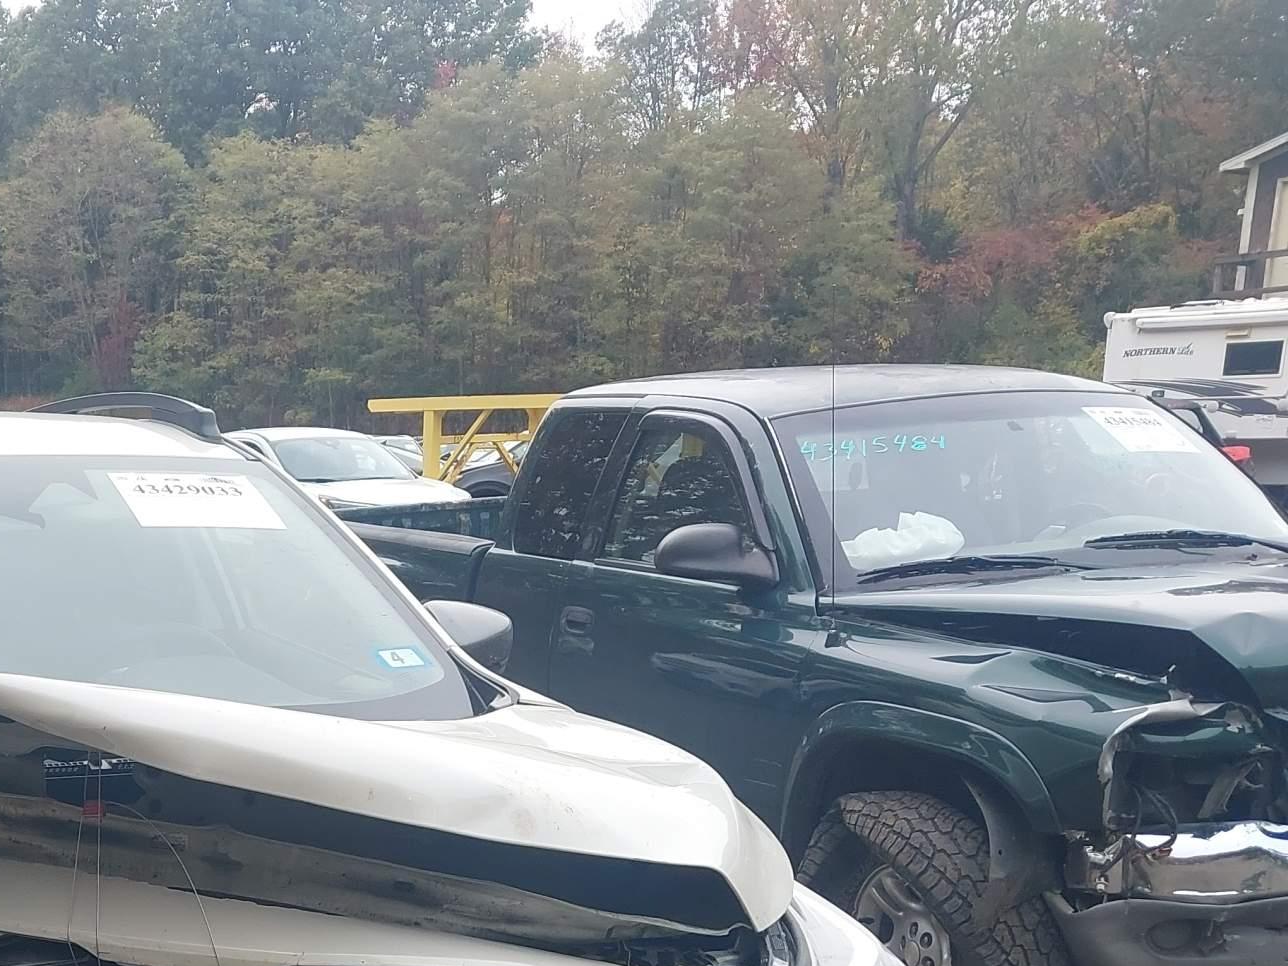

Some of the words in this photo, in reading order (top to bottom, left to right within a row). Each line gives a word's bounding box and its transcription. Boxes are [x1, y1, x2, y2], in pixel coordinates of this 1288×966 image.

[1123, 347, 1176, 358] NORTHERN
[800, 434, 945, 461] 43415484
[133, 483, 243, 497] 43429033
